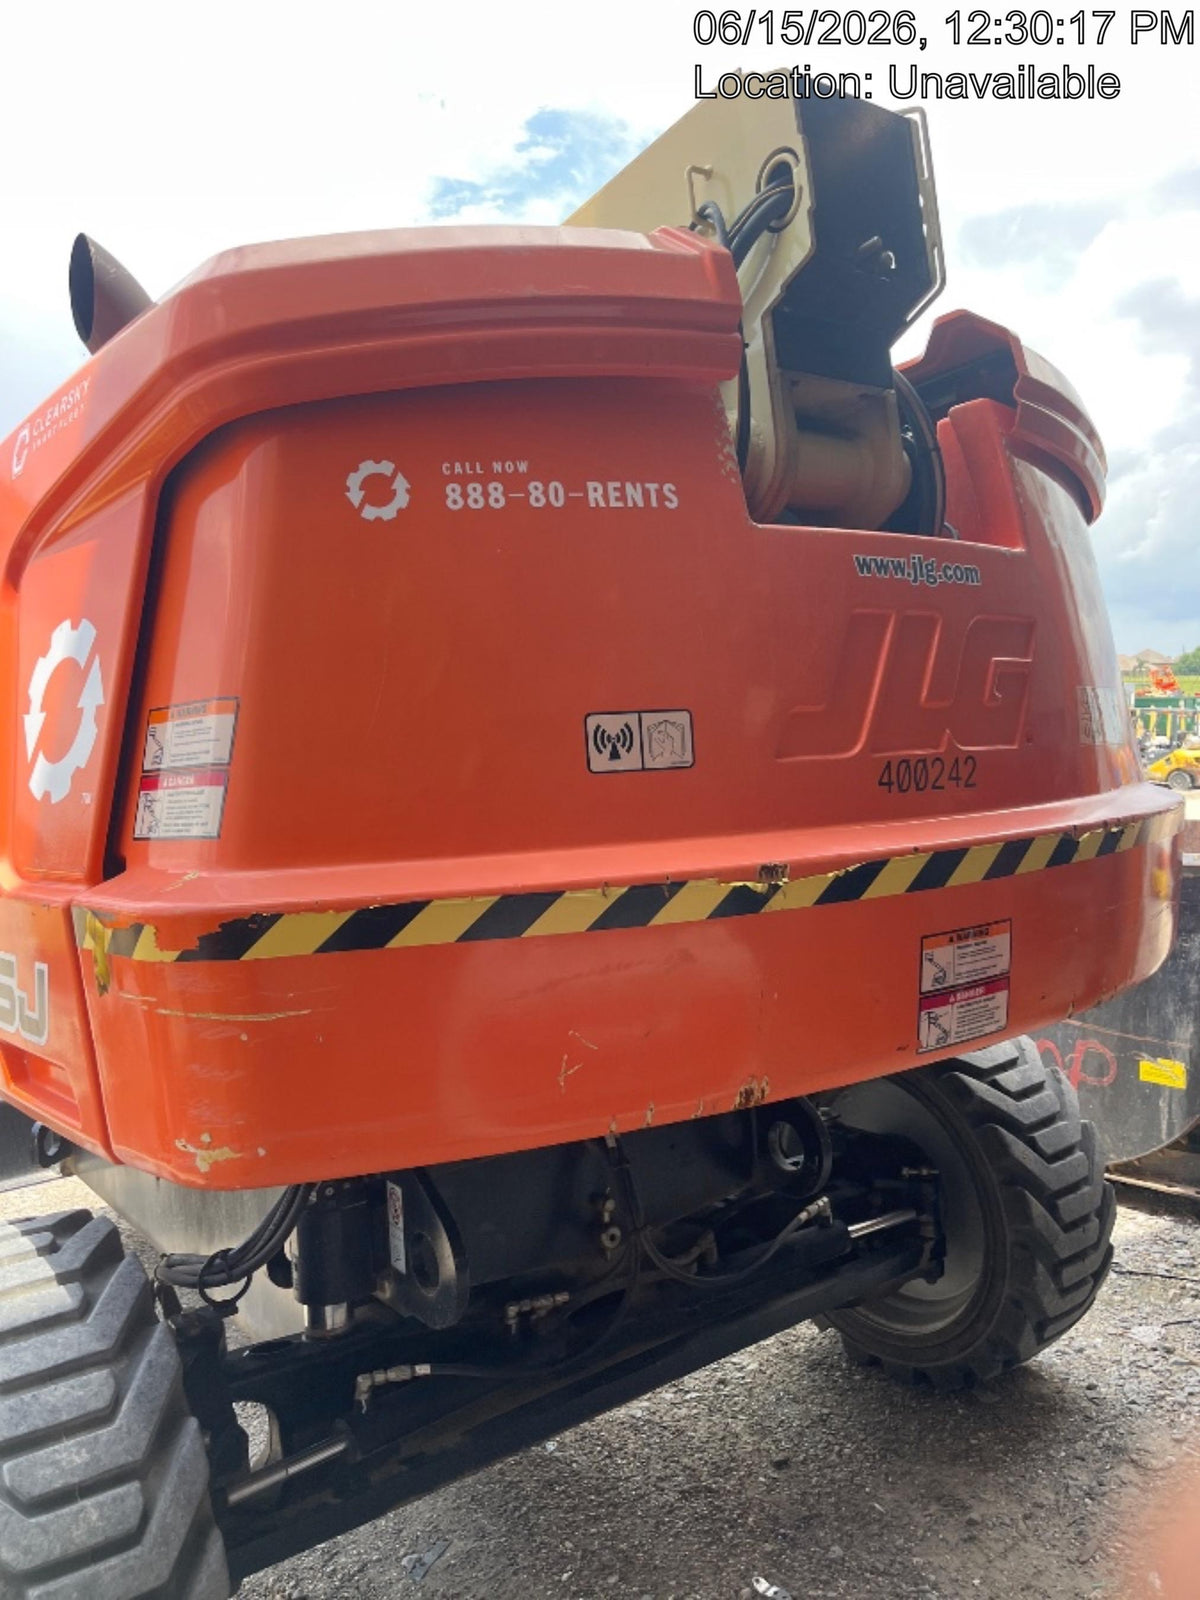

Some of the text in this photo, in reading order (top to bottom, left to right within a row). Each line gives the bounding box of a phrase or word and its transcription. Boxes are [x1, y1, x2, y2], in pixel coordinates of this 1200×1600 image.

[442, 460, 529, 475] CALL NOW
[445, 480, 679, 511] 888-80-RENTS
[853, 554, 982, 587] www.jlg.com
[774, 607, 1037, 763] JLG
[878, 754, 978, 794] 400242
